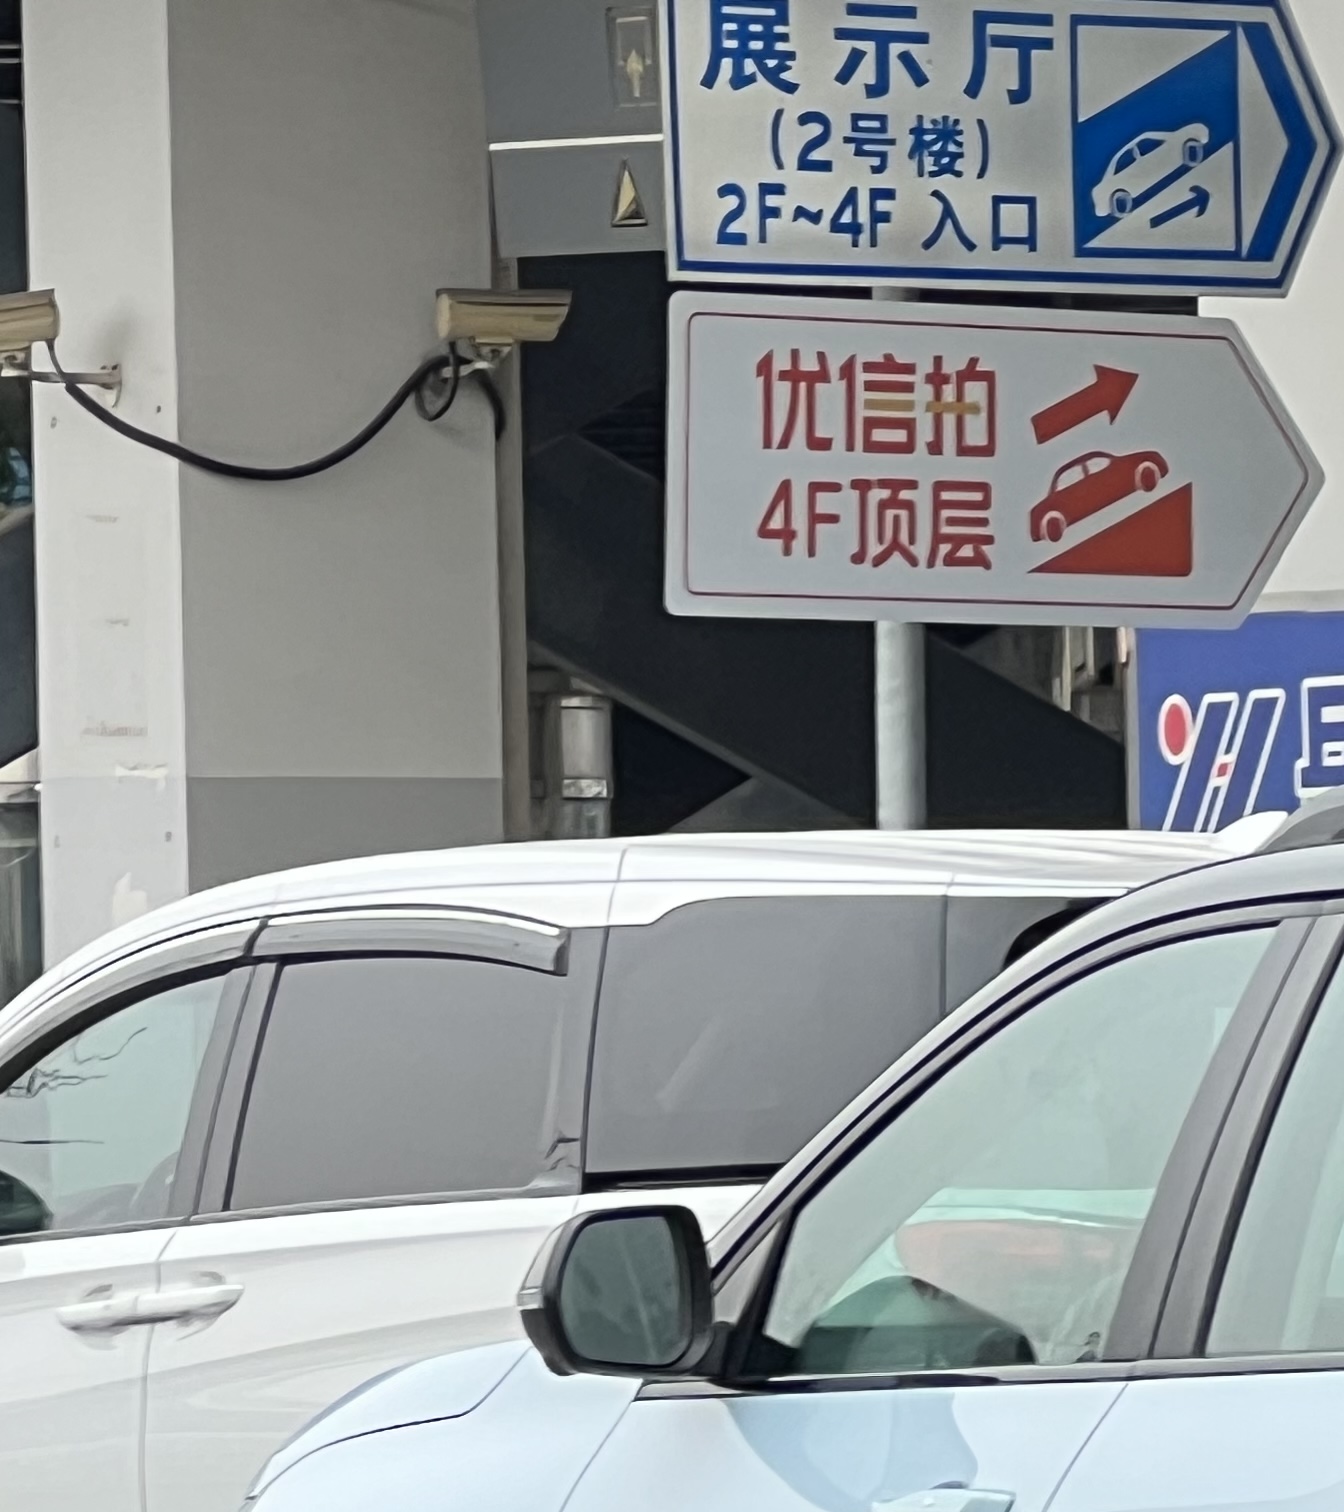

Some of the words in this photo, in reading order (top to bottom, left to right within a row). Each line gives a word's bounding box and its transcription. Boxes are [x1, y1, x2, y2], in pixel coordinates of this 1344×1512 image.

[700, 0, 1053, 104] 展示厅
[772, 108, 990, 181] (2号楼)
[716, 183, 897, 248] 2F~4F
[921, 190, 1037, 253] 入口
[756, 348, 996, 457] 优信拍
[757, 478, 995, 570] 4F顶层
